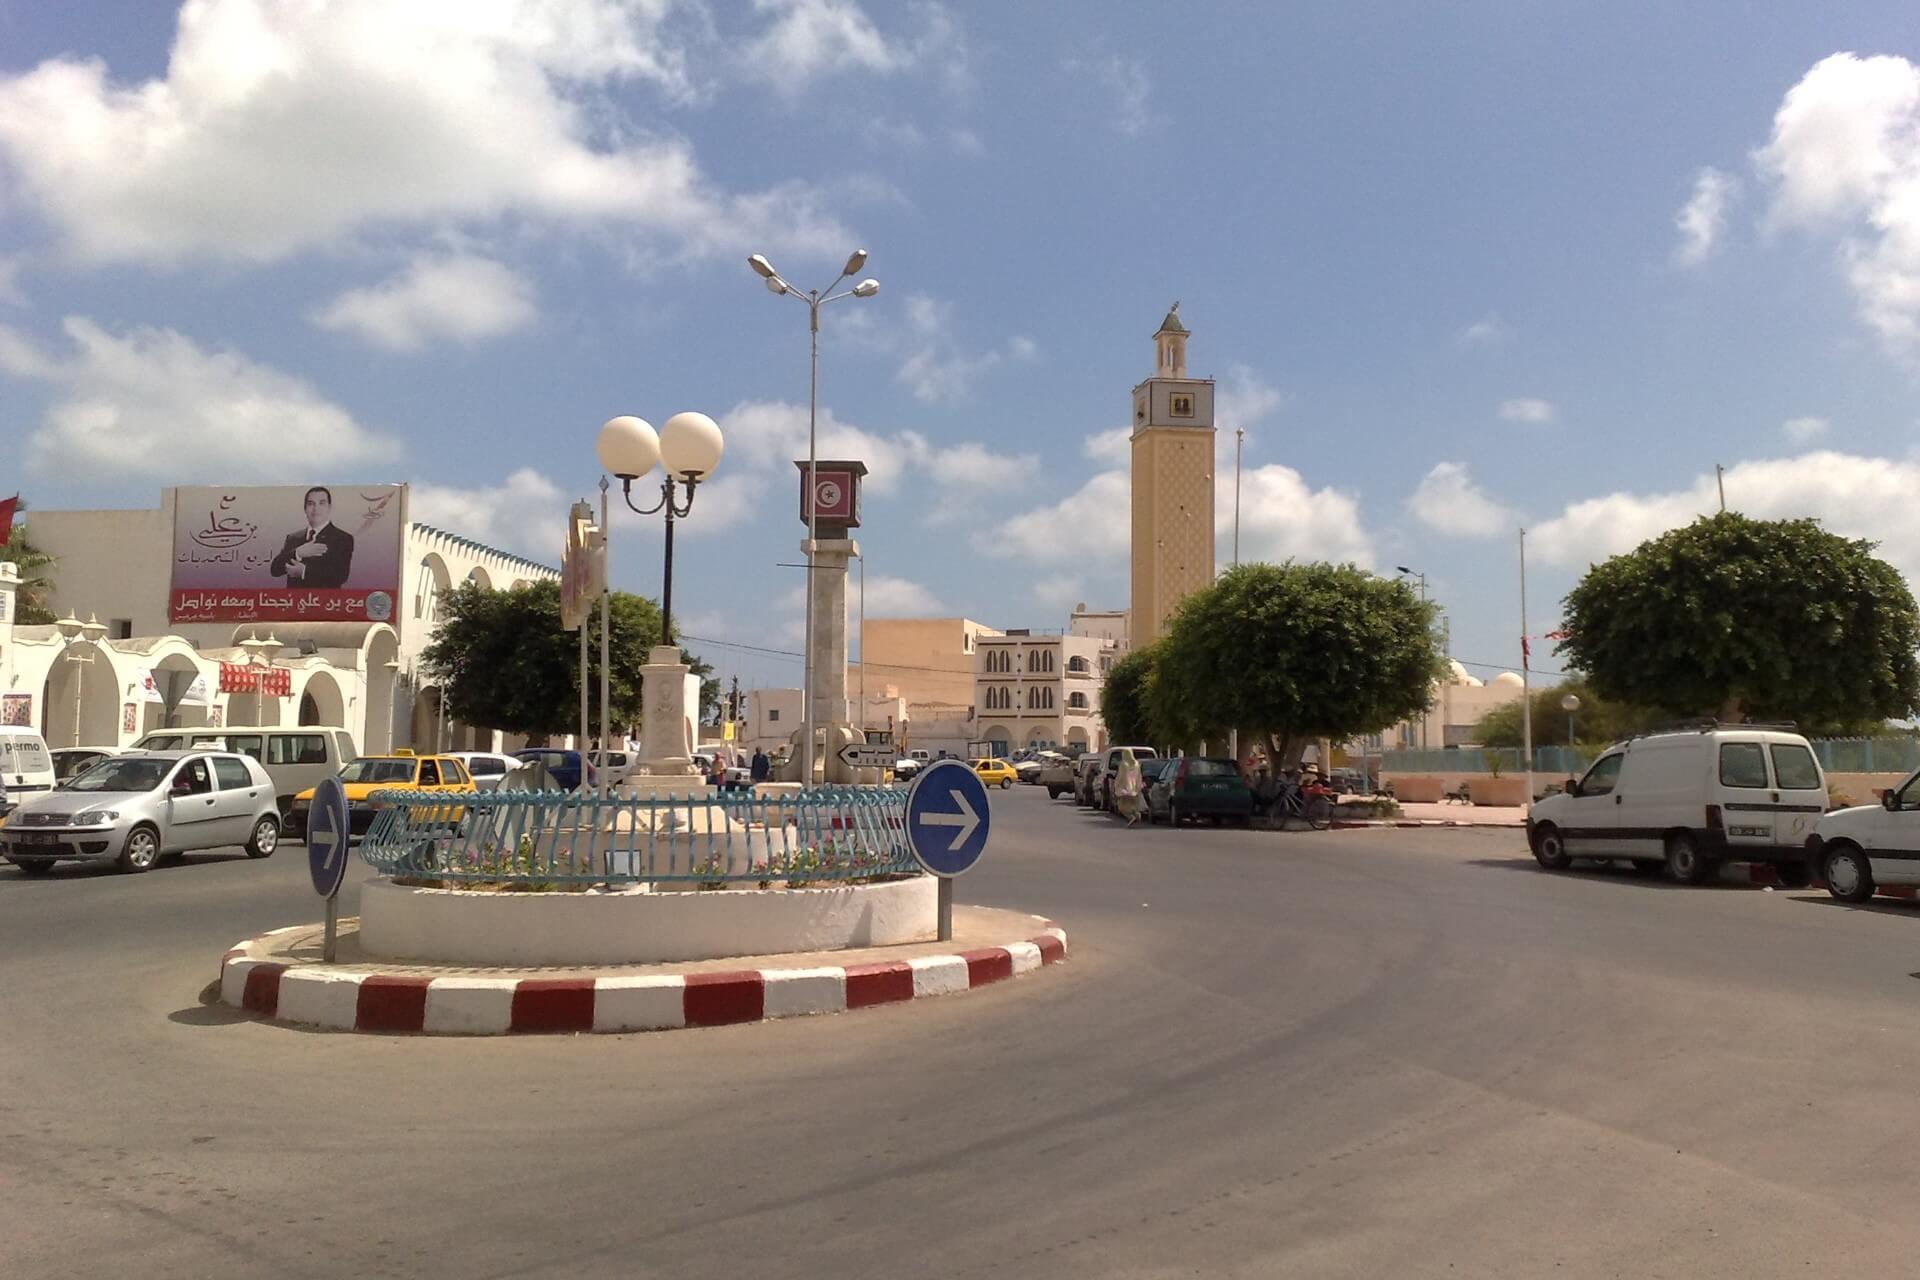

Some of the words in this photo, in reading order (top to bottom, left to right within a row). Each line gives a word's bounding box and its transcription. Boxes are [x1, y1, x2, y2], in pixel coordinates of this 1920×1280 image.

[220, 496, 236, 510] مع
[175, 593, 217, 611] نواصل
[221, 595, 255, 611] ومعه
[259, 592, 293, 612] نجحنا
[297, 592, 321, 613] علي
[325, 599, 341, 612] بن
[345, 598, 364, 613] مع
[5, 742, 40, 755] permo
